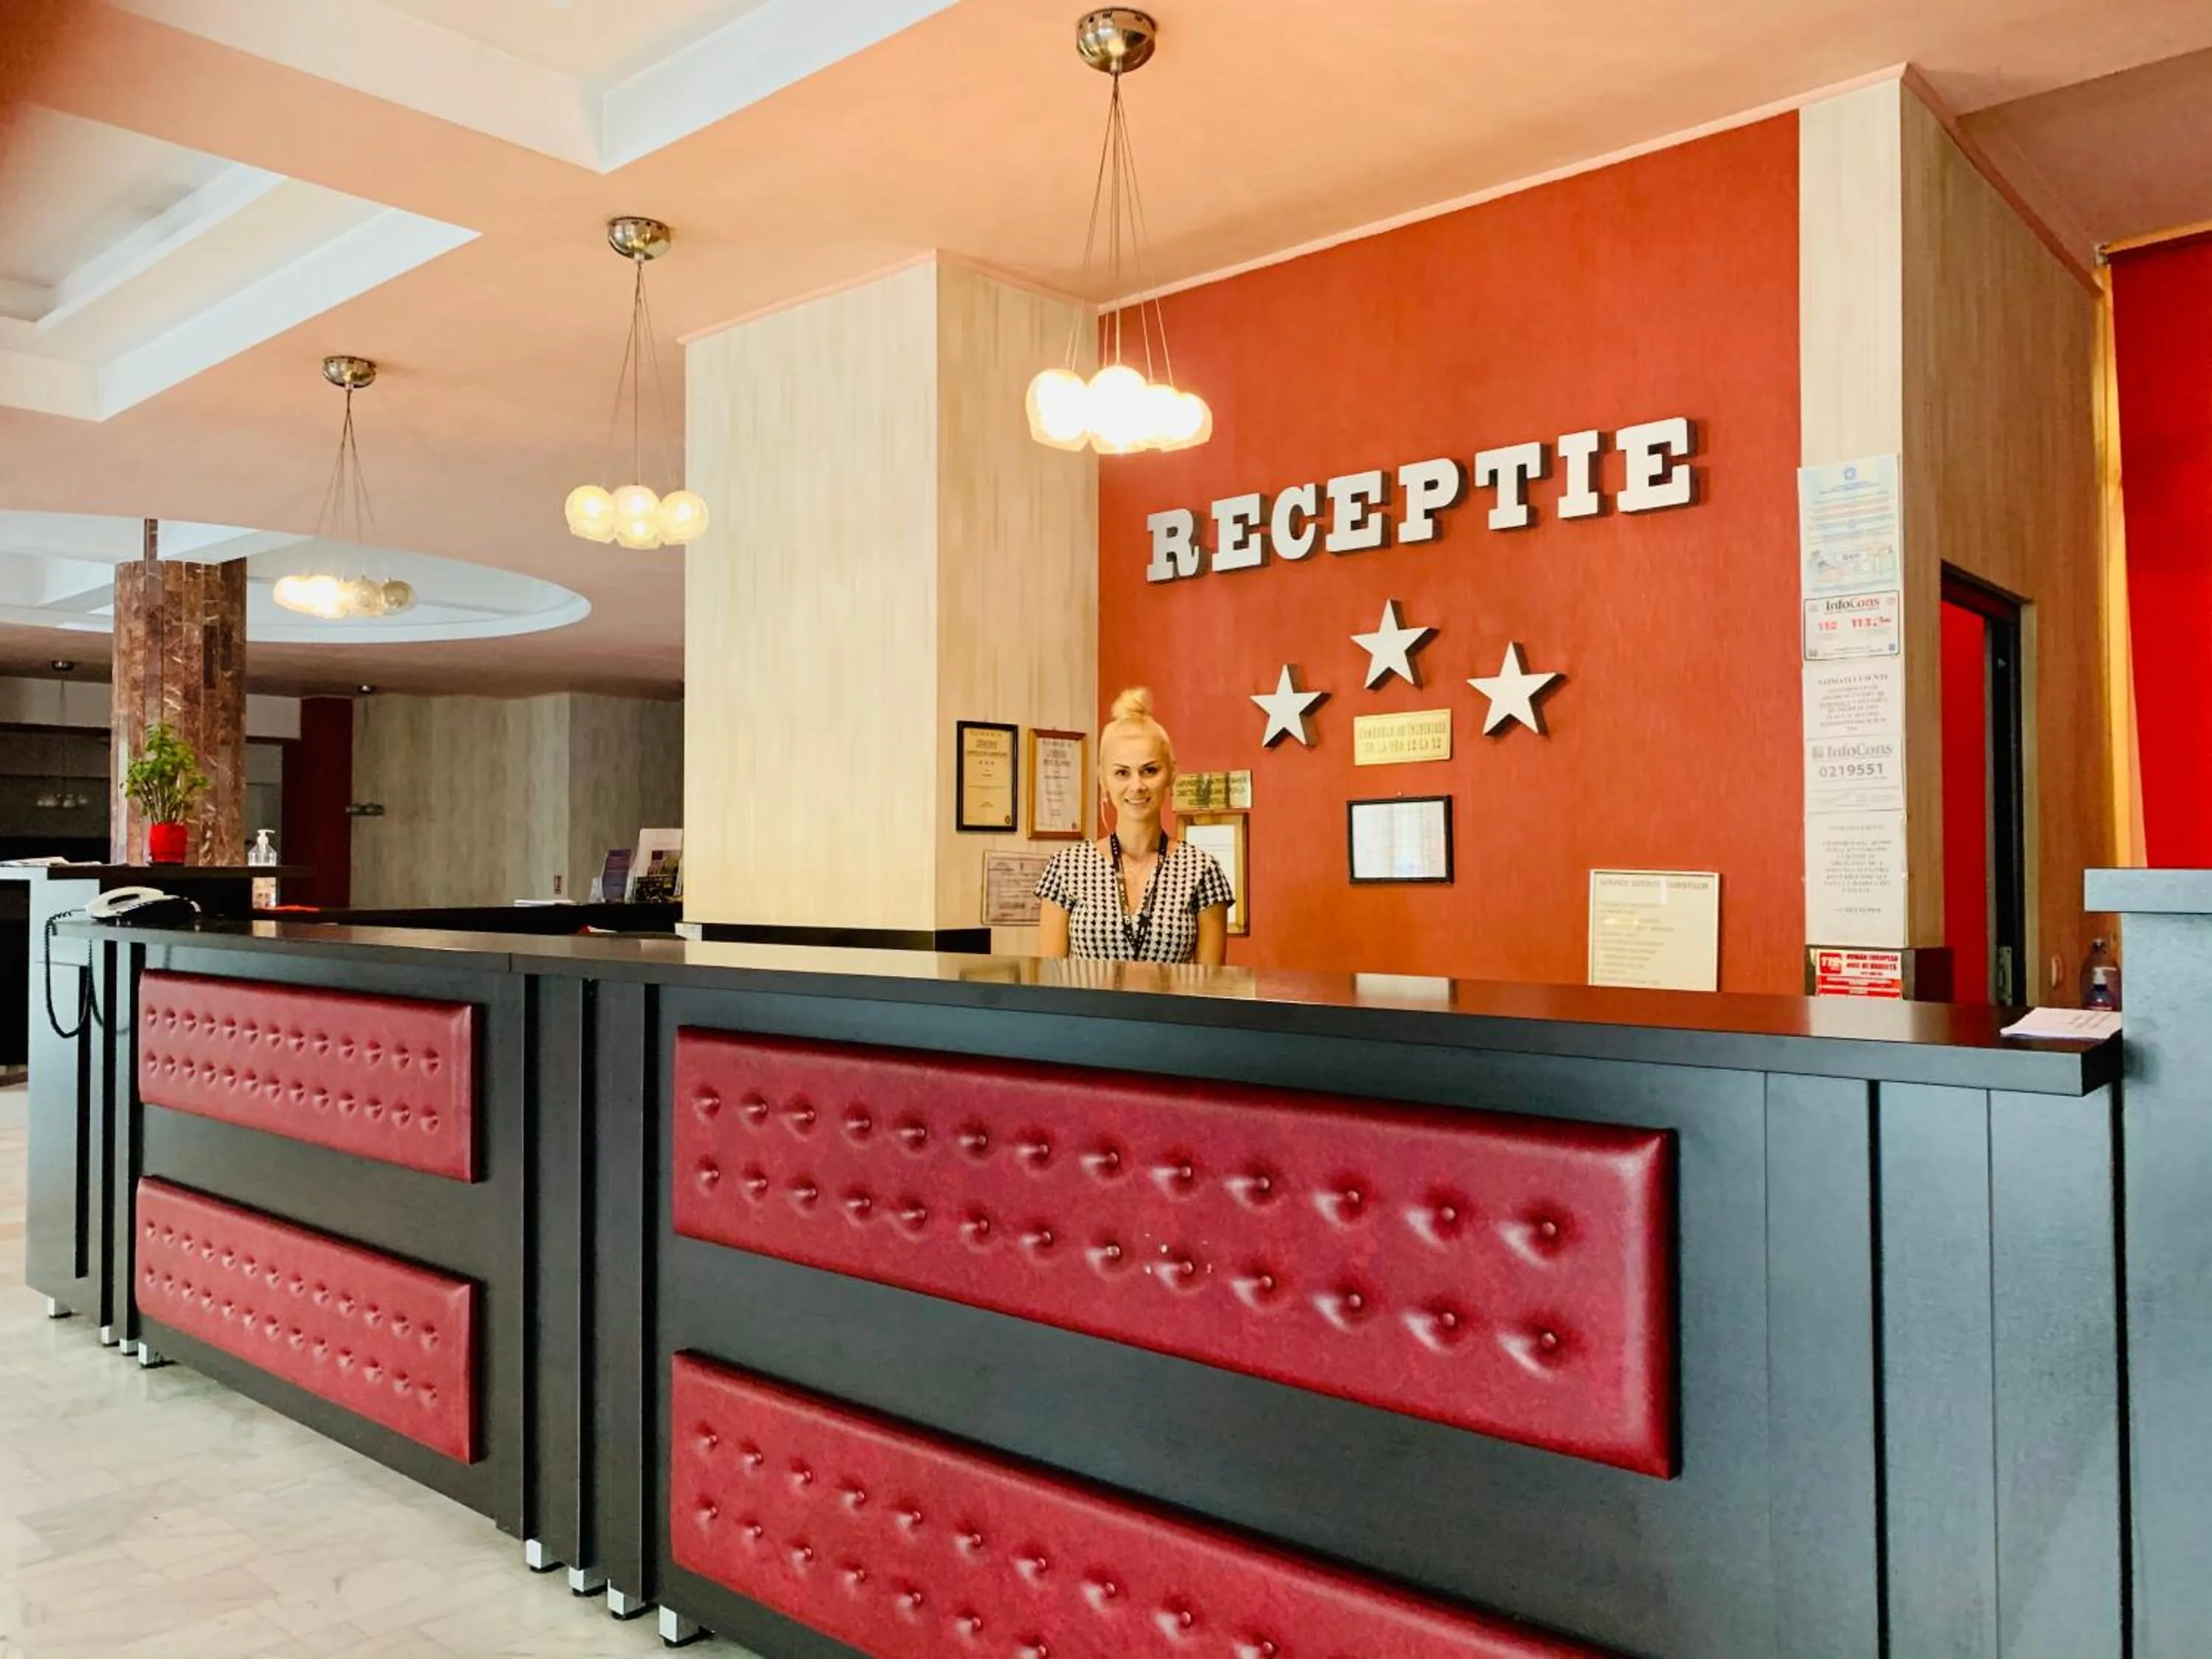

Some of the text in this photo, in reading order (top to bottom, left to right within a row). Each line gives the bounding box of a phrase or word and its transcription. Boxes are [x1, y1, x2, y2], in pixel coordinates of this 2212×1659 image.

[1147, 417, 1694, 582] RECEPTIE
[1826, 597, 1879, 611] InfoCons
[1827, 742, 1893, 759] InfoCons
[1819, 762, 1883, 778] 0219551
